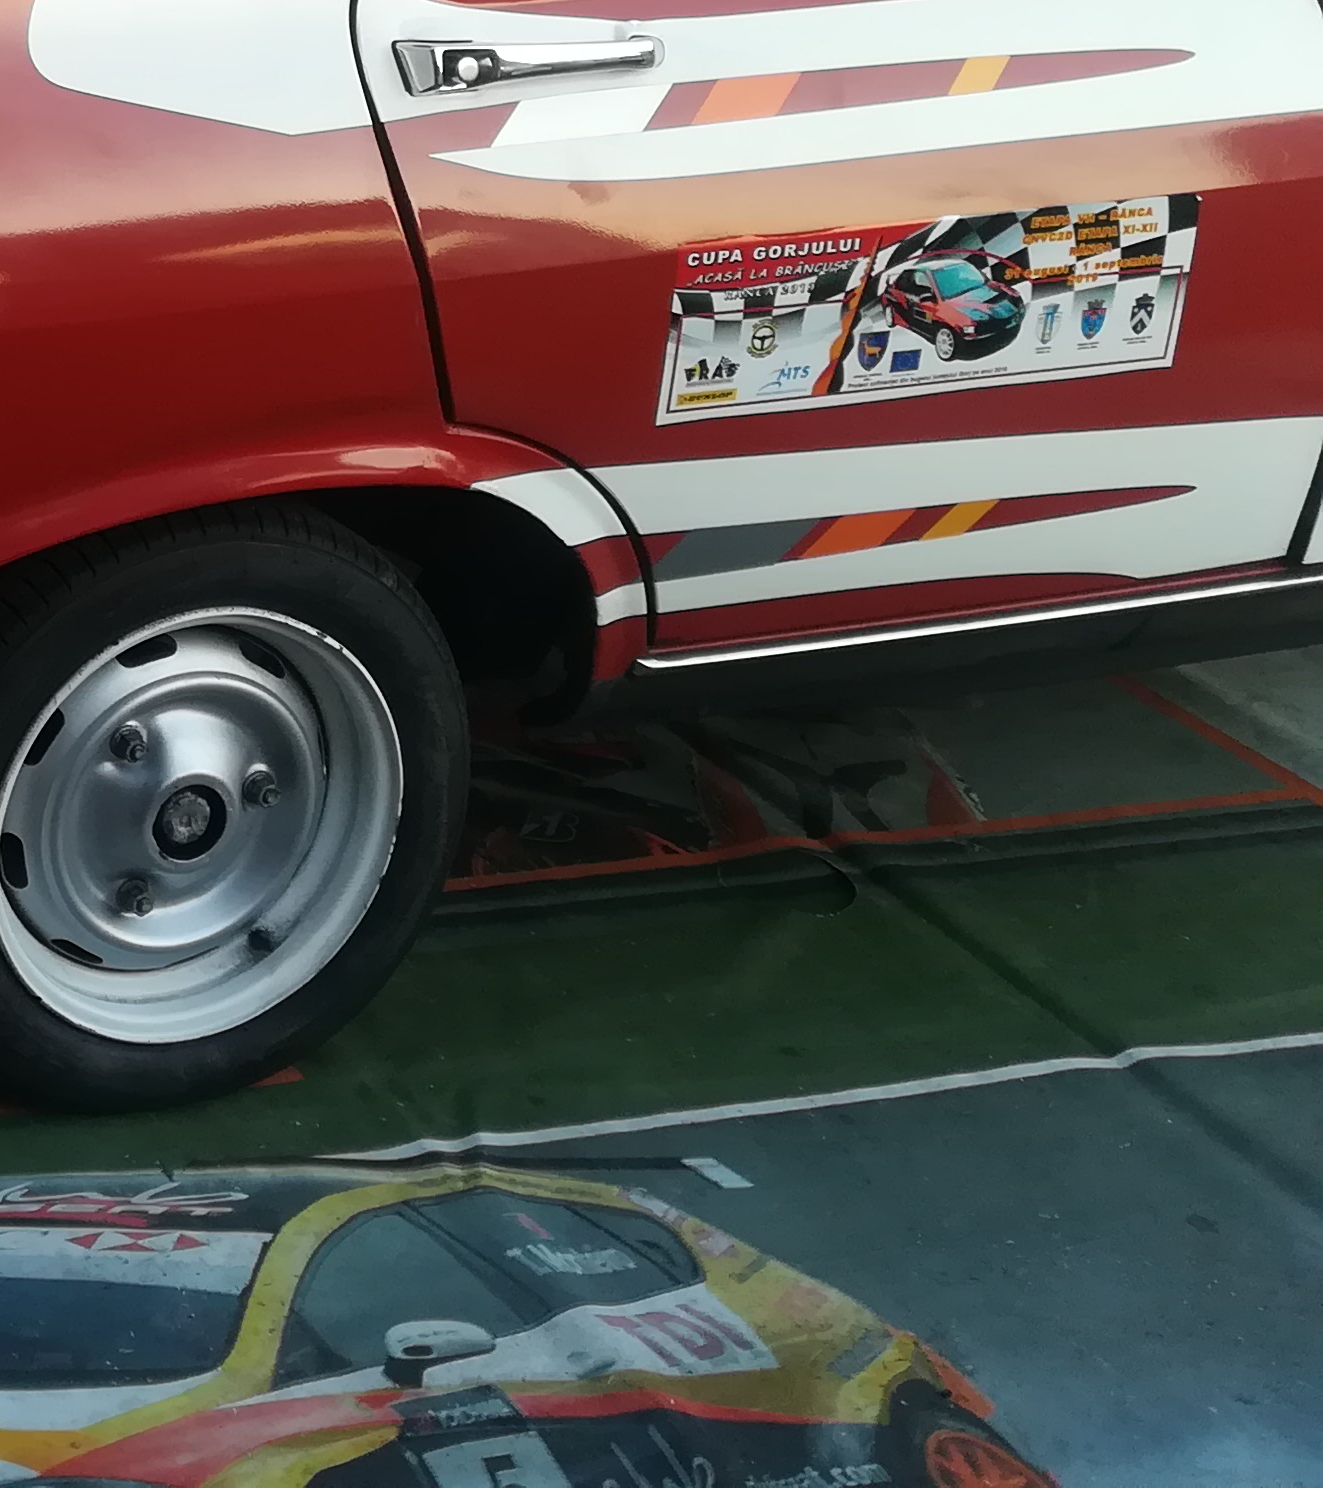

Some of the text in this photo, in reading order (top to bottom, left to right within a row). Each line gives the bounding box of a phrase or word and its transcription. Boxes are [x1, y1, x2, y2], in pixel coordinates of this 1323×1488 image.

[687, 238, 862, 267] CUPA GORJULUI
[749, 268, 768, 280] LA
[776, 365, 811, 381] MTS
[598, 1303, 755, 1368] TDI
